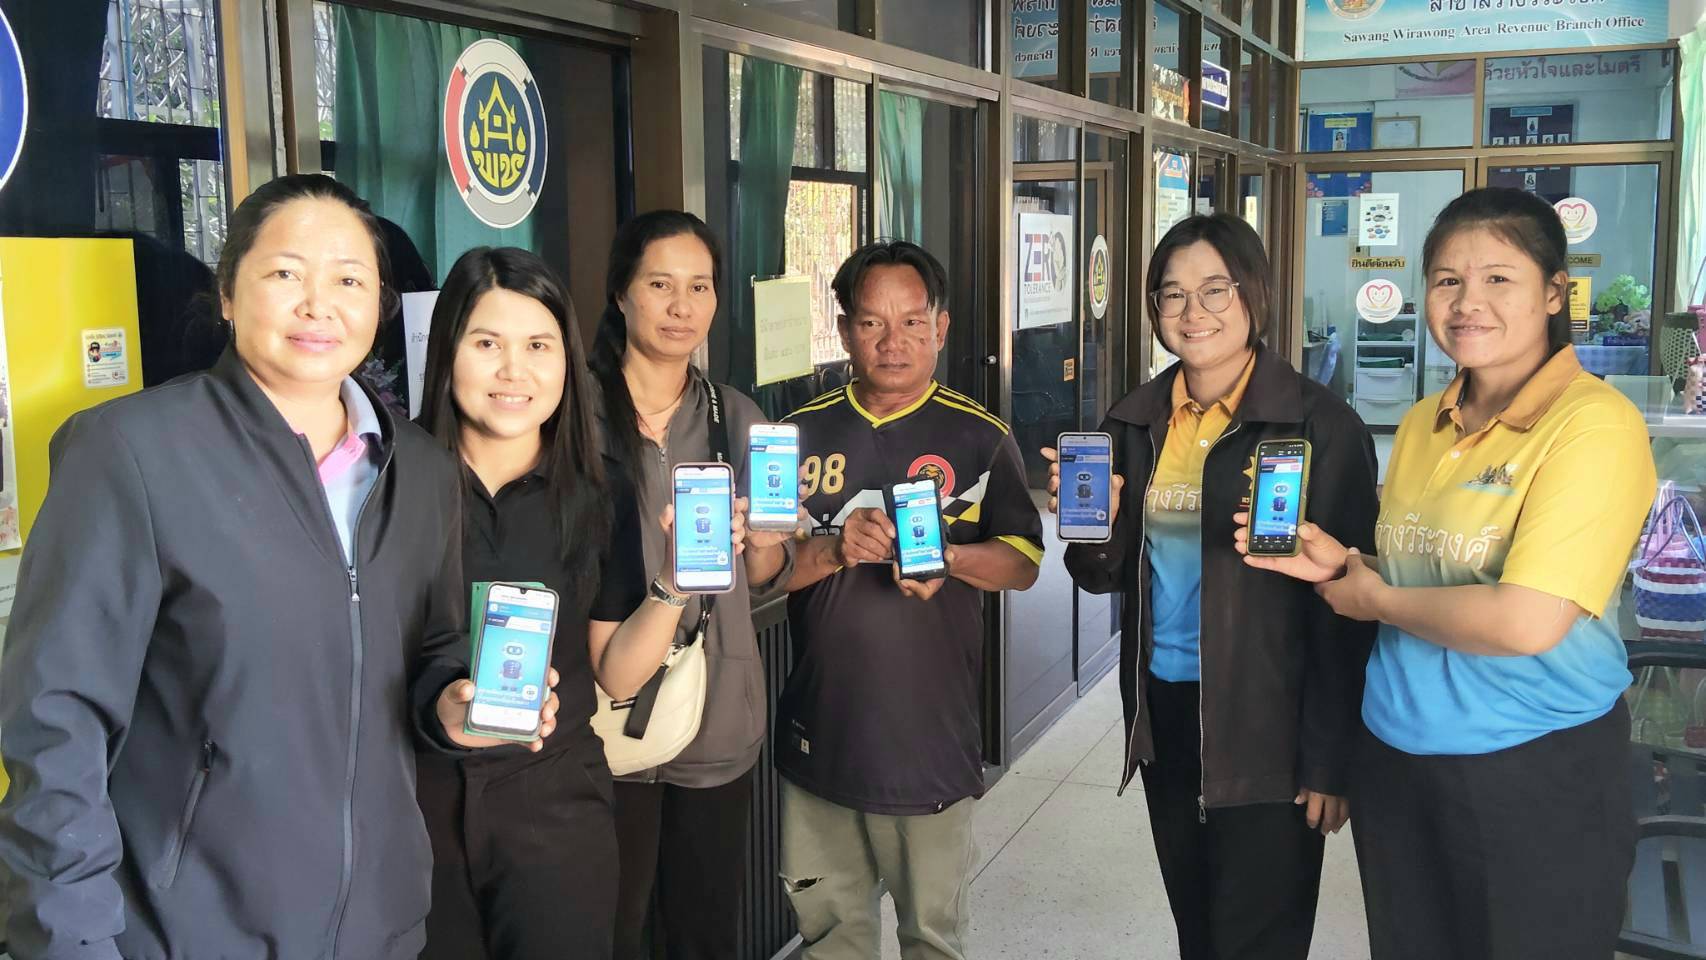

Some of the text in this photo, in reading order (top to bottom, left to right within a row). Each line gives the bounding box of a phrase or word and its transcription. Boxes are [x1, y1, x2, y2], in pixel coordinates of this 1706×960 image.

[1344, 15, 1645, 43] Sawang Wirawong Area Revenue Branch Office
[1567, 256, 1593, 265] COME
[804, 453, 846, 495] 98
[1375, 510, 1503, 570] ว่างวีระวงศ์
